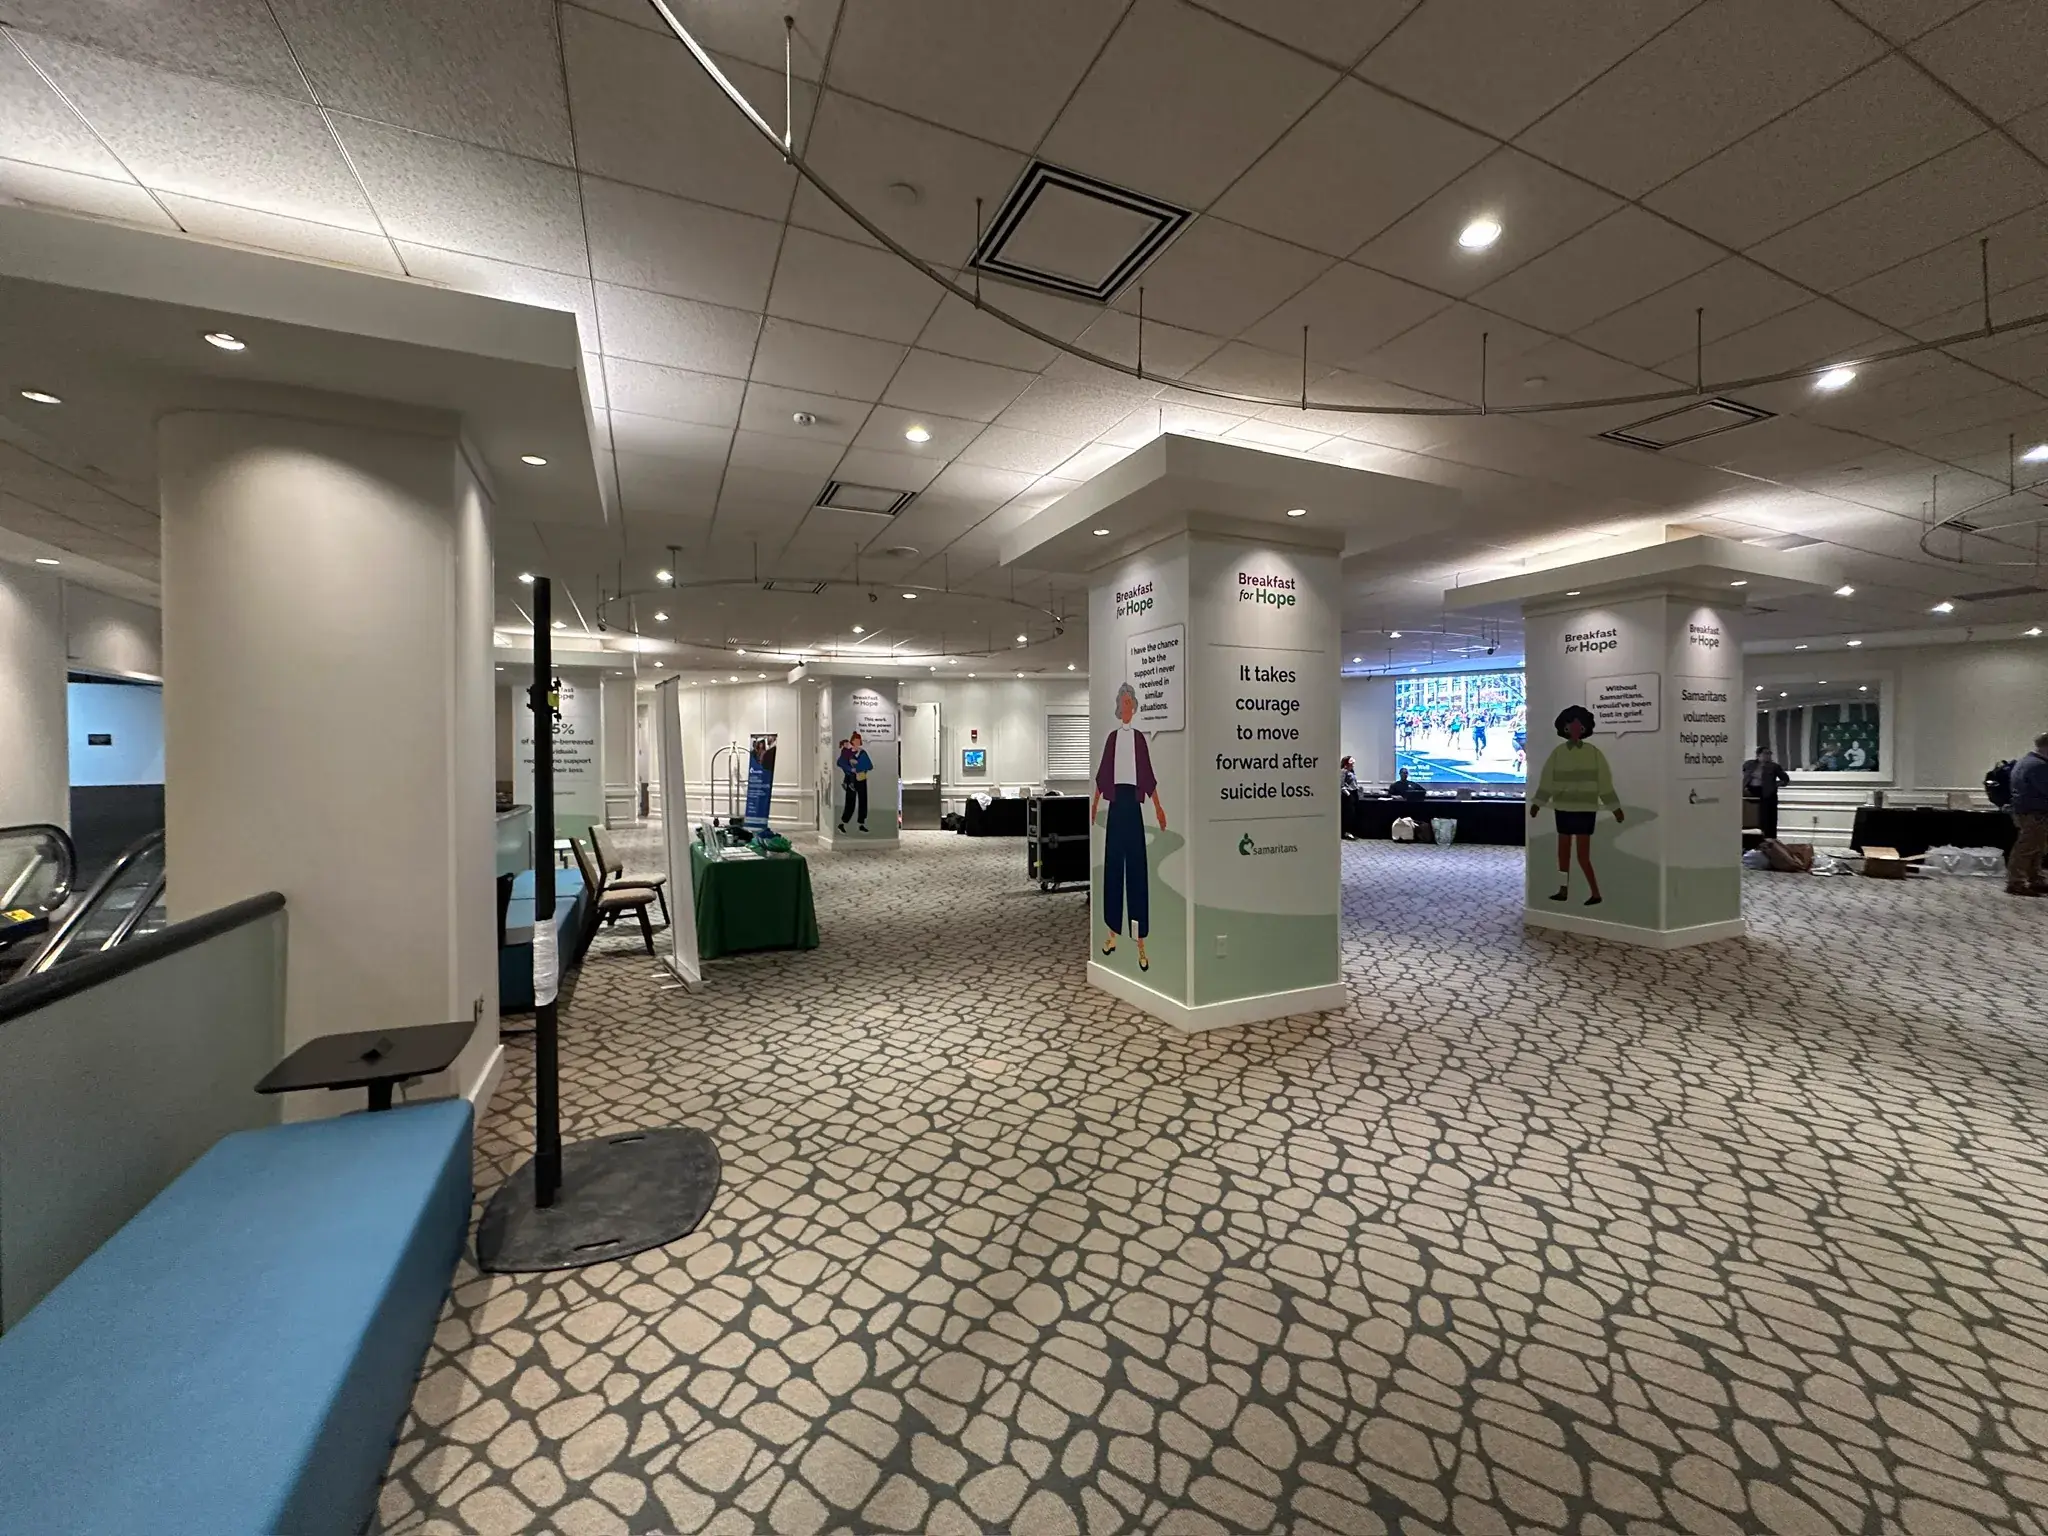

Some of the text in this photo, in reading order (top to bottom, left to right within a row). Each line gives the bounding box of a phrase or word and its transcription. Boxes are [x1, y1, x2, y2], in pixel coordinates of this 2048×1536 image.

[1238, 572, 1296, 590] Breakfast
[1116, 581, 1153, 603] Breakfast
[1239, 588, 1296, 609] for Hope
[1117, 597, 1153, 619] for Hope
[1565, 628, 1617, 642] Breakfast
[1689, 624, 1720, 635] Breakfast
[1134, 647, 1146, 655] have
[1147, 643, 1156, 652] the
[1157, 639, 1179, 650] chance
[1565, 640, 1617, 654] for Hope
[1690, 635, 1719, 649] for Hope
[1142, 653, 1166, 665] to be the
[1134, 667, 1155, 678] support
[1159, 664, 1175, 673] never
[1239, 665, 1296, 683] It takes
[1139, 677, 1170, 689] received in
[1605, 684, 1637, 692] Without
[1144, 690, 1164, 700] similar
[1681, 690, 1727, 703] Samaritans
[1140, 702, 1168, 712] situations.
[1235, 697, 1300, 716] courage
[1682, 711, 1726, 724] volunteers
[551, 723, 575, 735] 5%
[1236, 724, 1300, 740] to move
[1680, 732, 1729, 747] help people
[1215, 753, 1319, 771] forward after
[1684, 752, 1724, 767] find hope.
[1220, 782, 1315, 800] suicide loss.
[1252, 844, 1298, 856] samaritans
